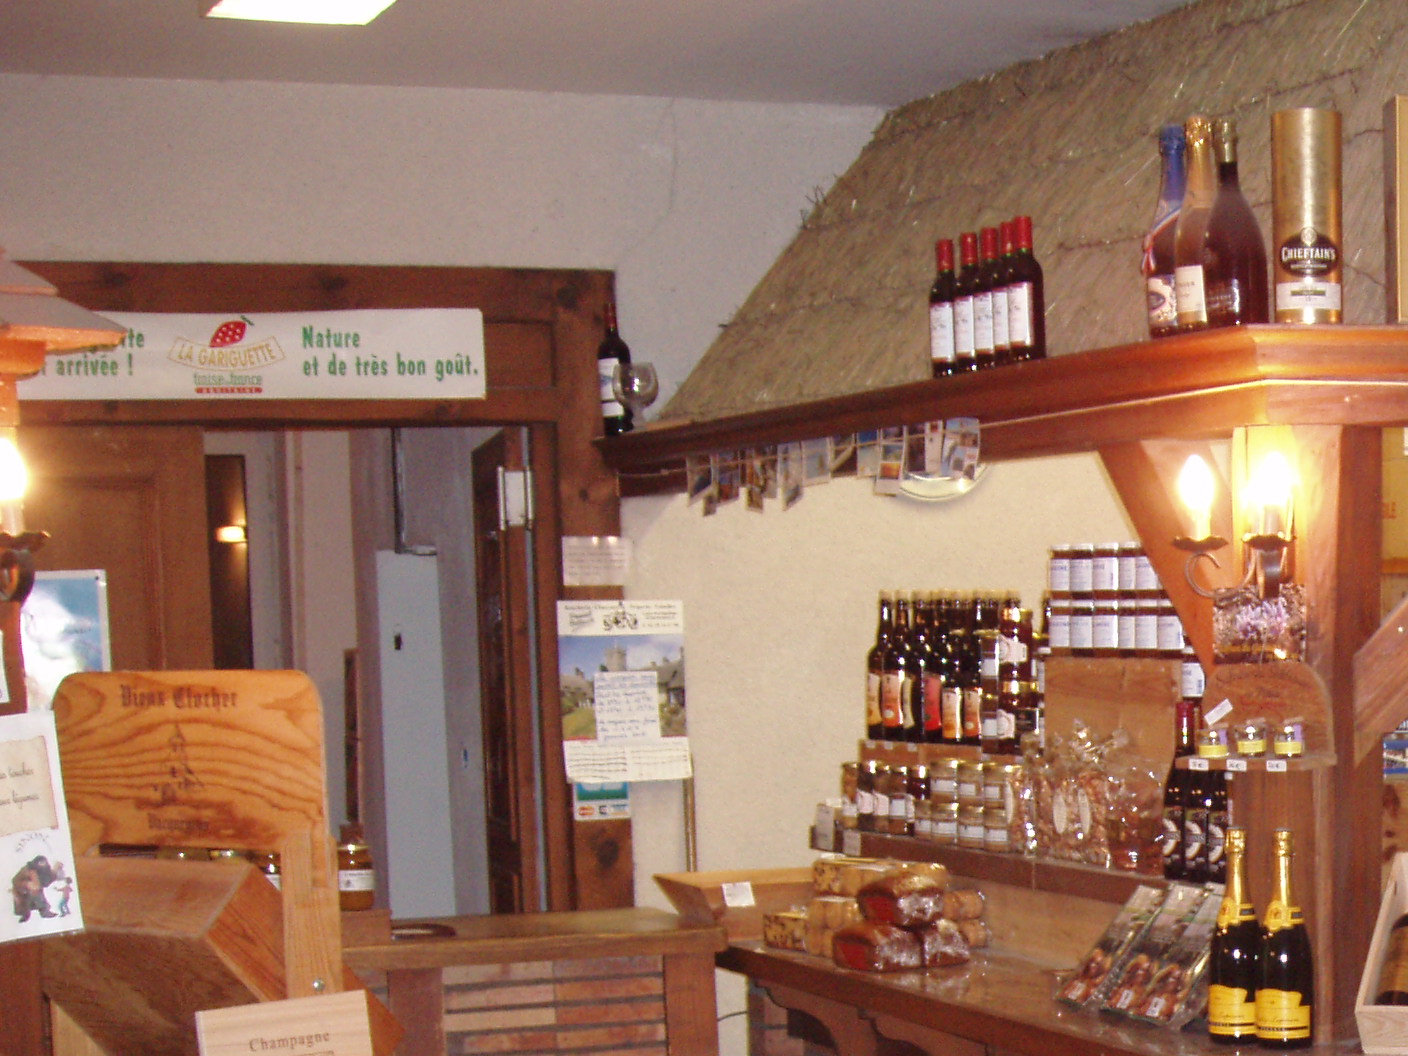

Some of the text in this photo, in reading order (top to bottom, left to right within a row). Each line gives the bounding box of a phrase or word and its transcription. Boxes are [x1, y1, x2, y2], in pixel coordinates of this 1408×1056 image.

[302, 325, 360, 348] Nature
[56, 354, 118, 376] arrivée
[177, 342, 276, 369] LA GARIGUETTE
[303, 352, 478, 382] et de très bon goût.
[249, 1031, 331, 1051] Champagne
